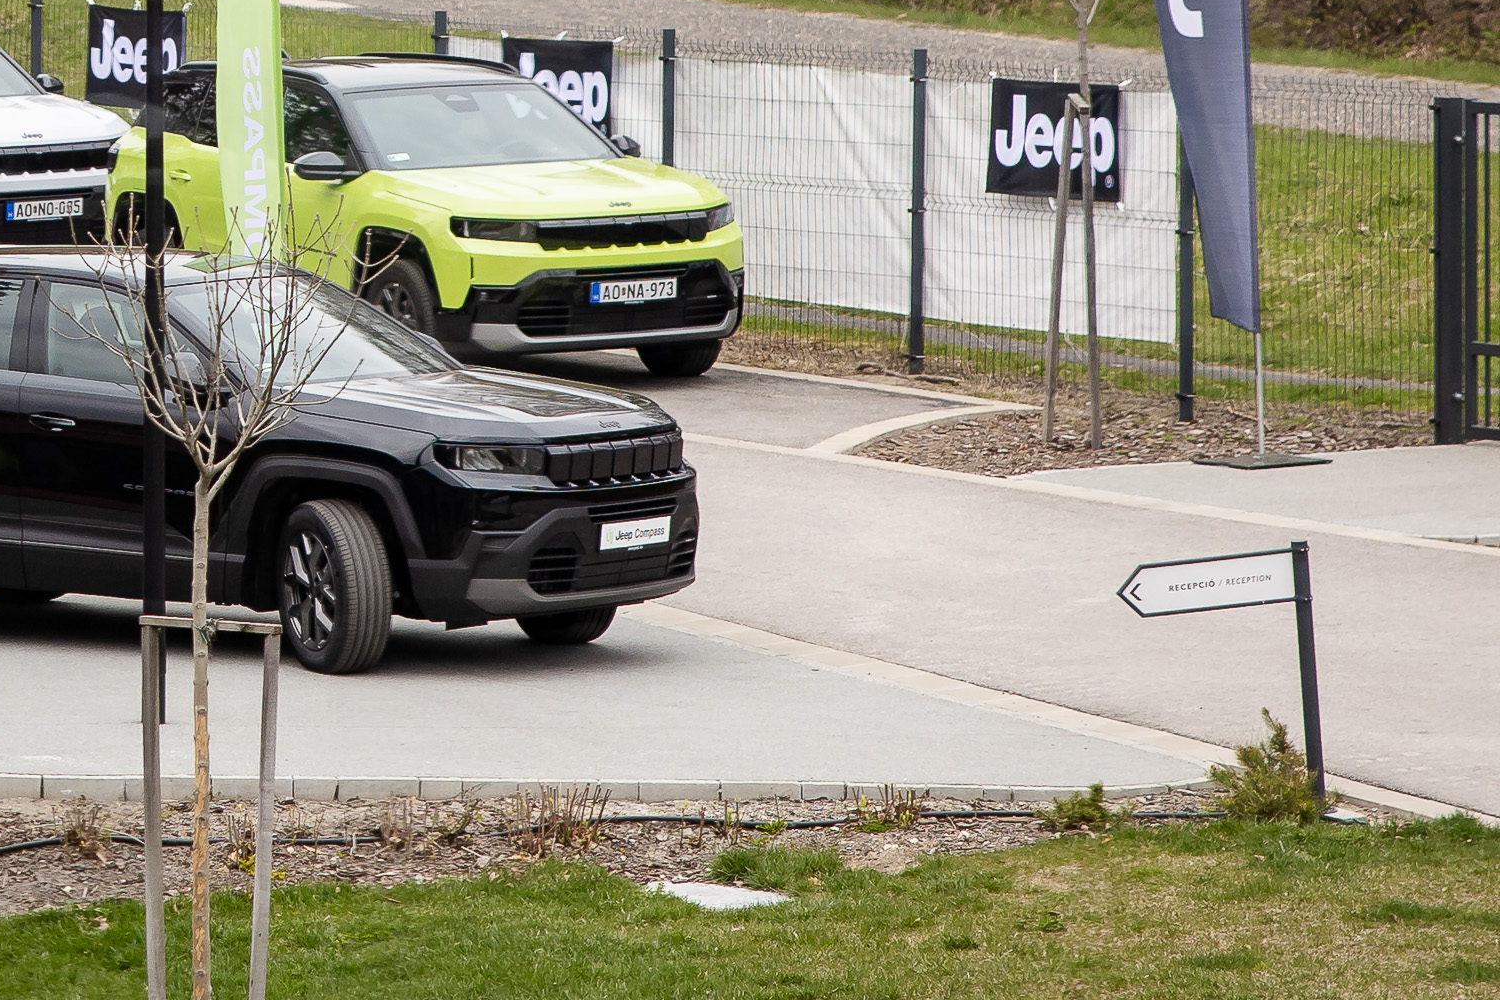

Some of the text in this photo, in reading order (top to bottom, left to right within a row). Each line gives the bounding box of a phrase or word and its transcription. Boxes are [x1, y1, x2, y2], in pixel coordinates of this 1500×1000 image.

[995, 94, 1115, 187] Jeep
[615, 529, 633, 542] Jeep
[634, 526, 665, 540] Compass
[1168, 578, 1216, 592] RECEPCIÓ
[1225, 574, 1272, 586] RECEPTION
